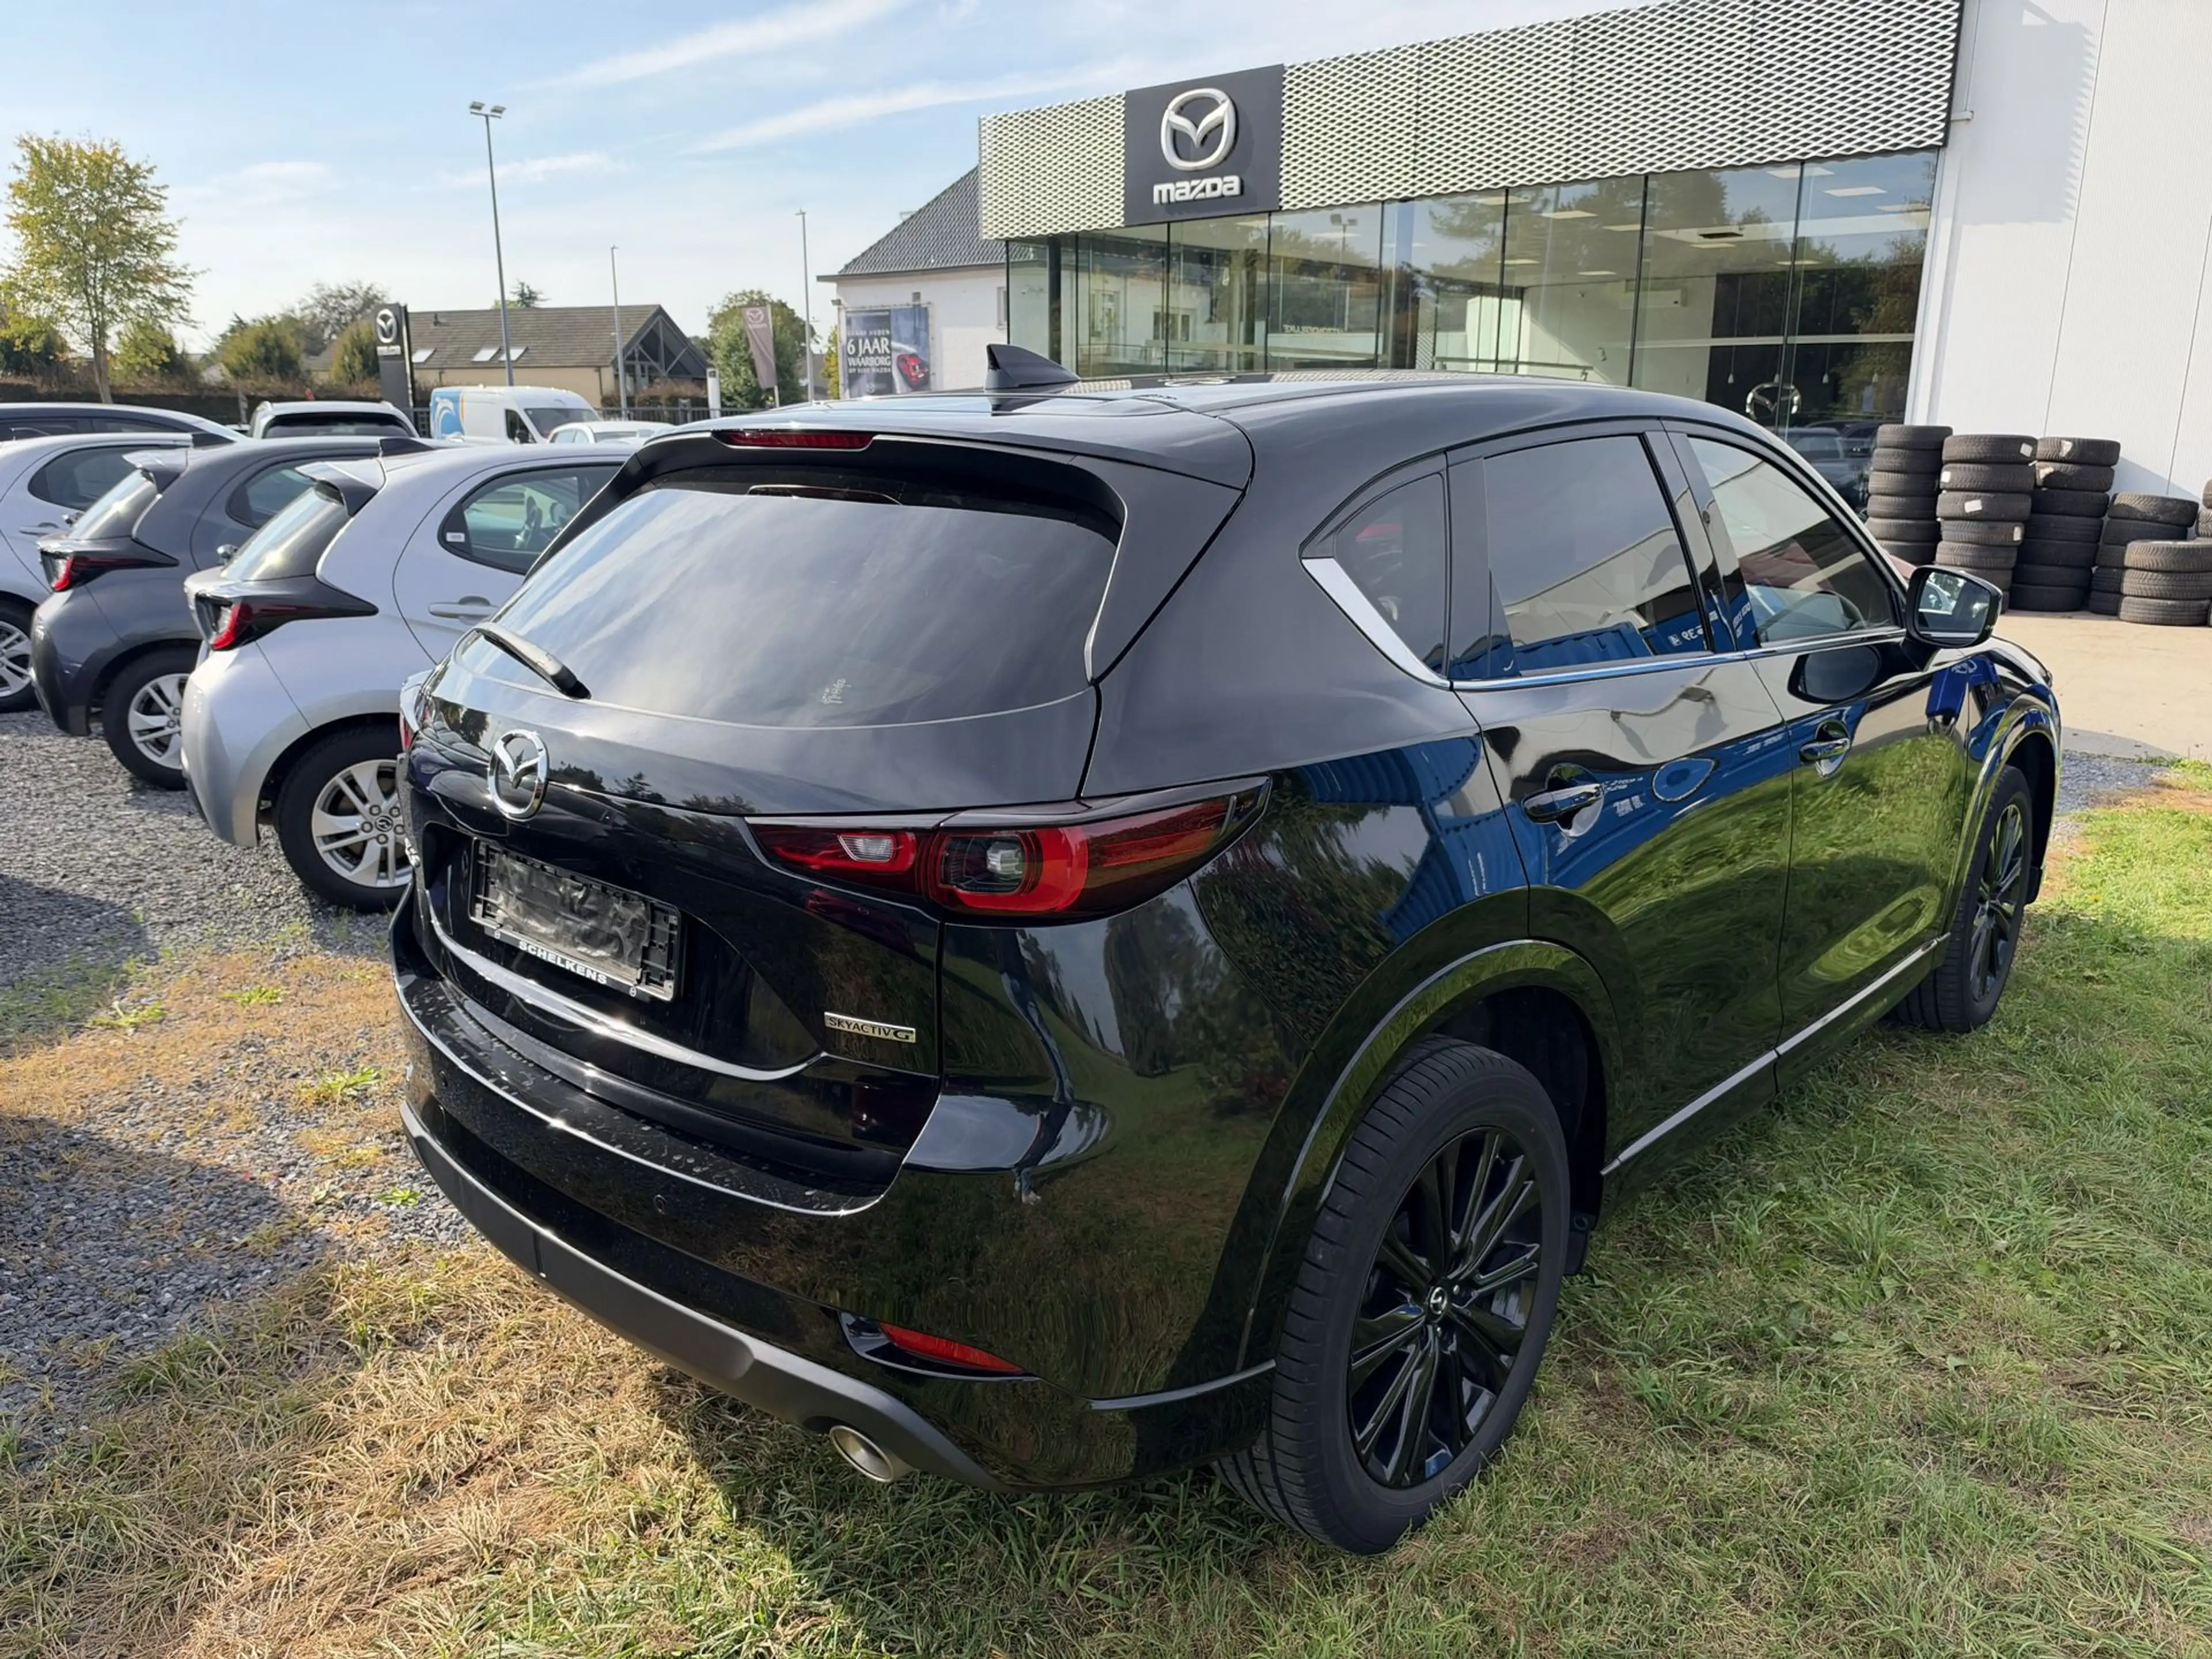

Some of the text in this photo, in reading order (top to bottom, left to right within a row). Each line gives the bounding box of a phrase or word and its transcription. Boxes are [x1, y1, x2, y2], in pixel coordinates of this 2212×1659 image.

[847, 337, 891, 357] 6 JAAR
[847, 356, 891, 367] WAARBORG
[518, 940, 607, 985] SCHELKENS
